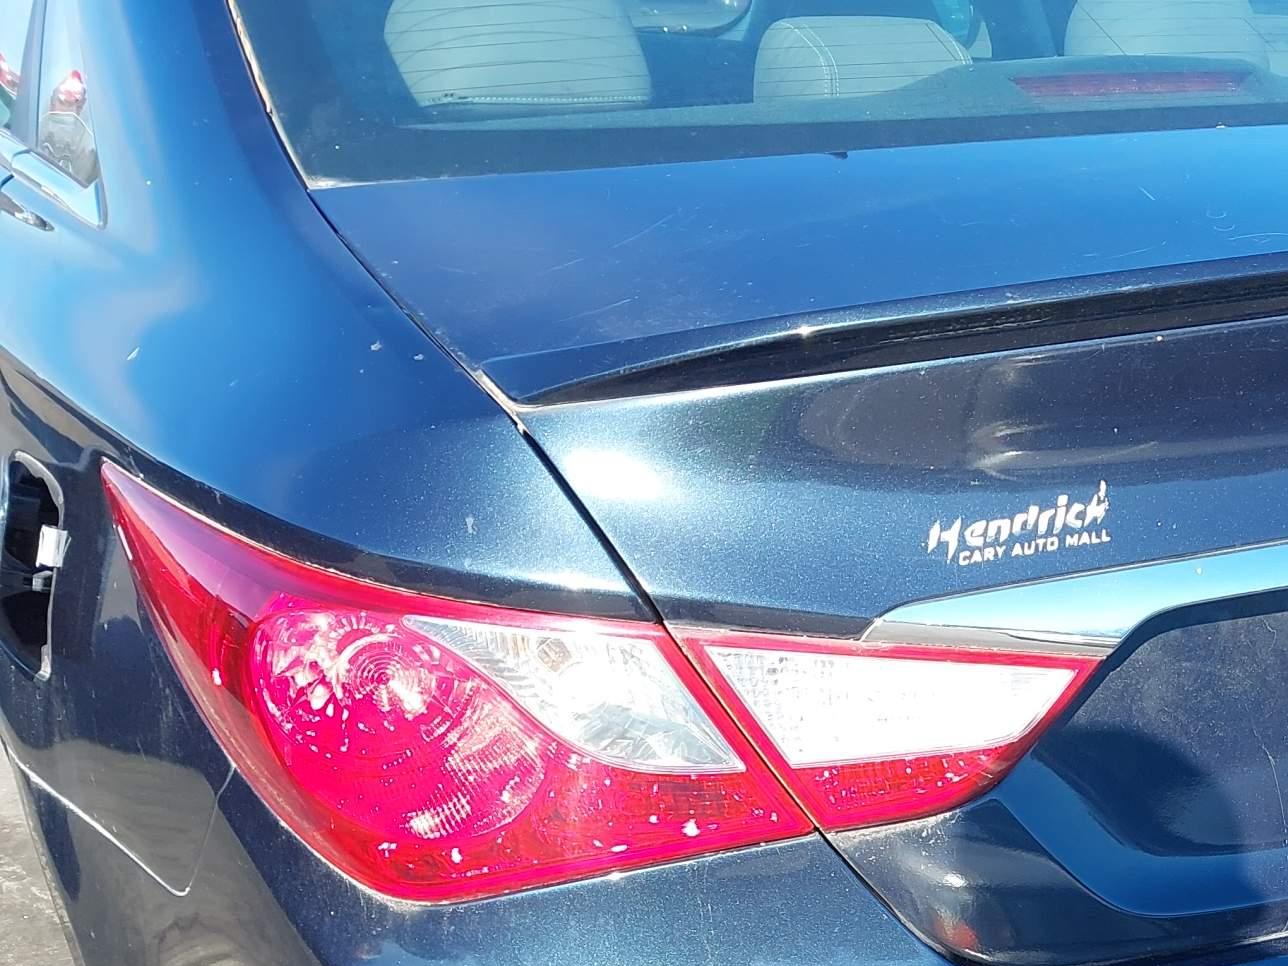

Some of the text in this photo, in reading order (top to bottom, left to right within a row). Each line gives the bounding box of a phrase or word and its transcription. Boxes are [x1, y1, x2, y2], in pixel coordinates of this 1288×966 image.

[928, 479, 1109, 564] Hendrick
[958, 528, 1111, 566] CARY AUTO MALL
